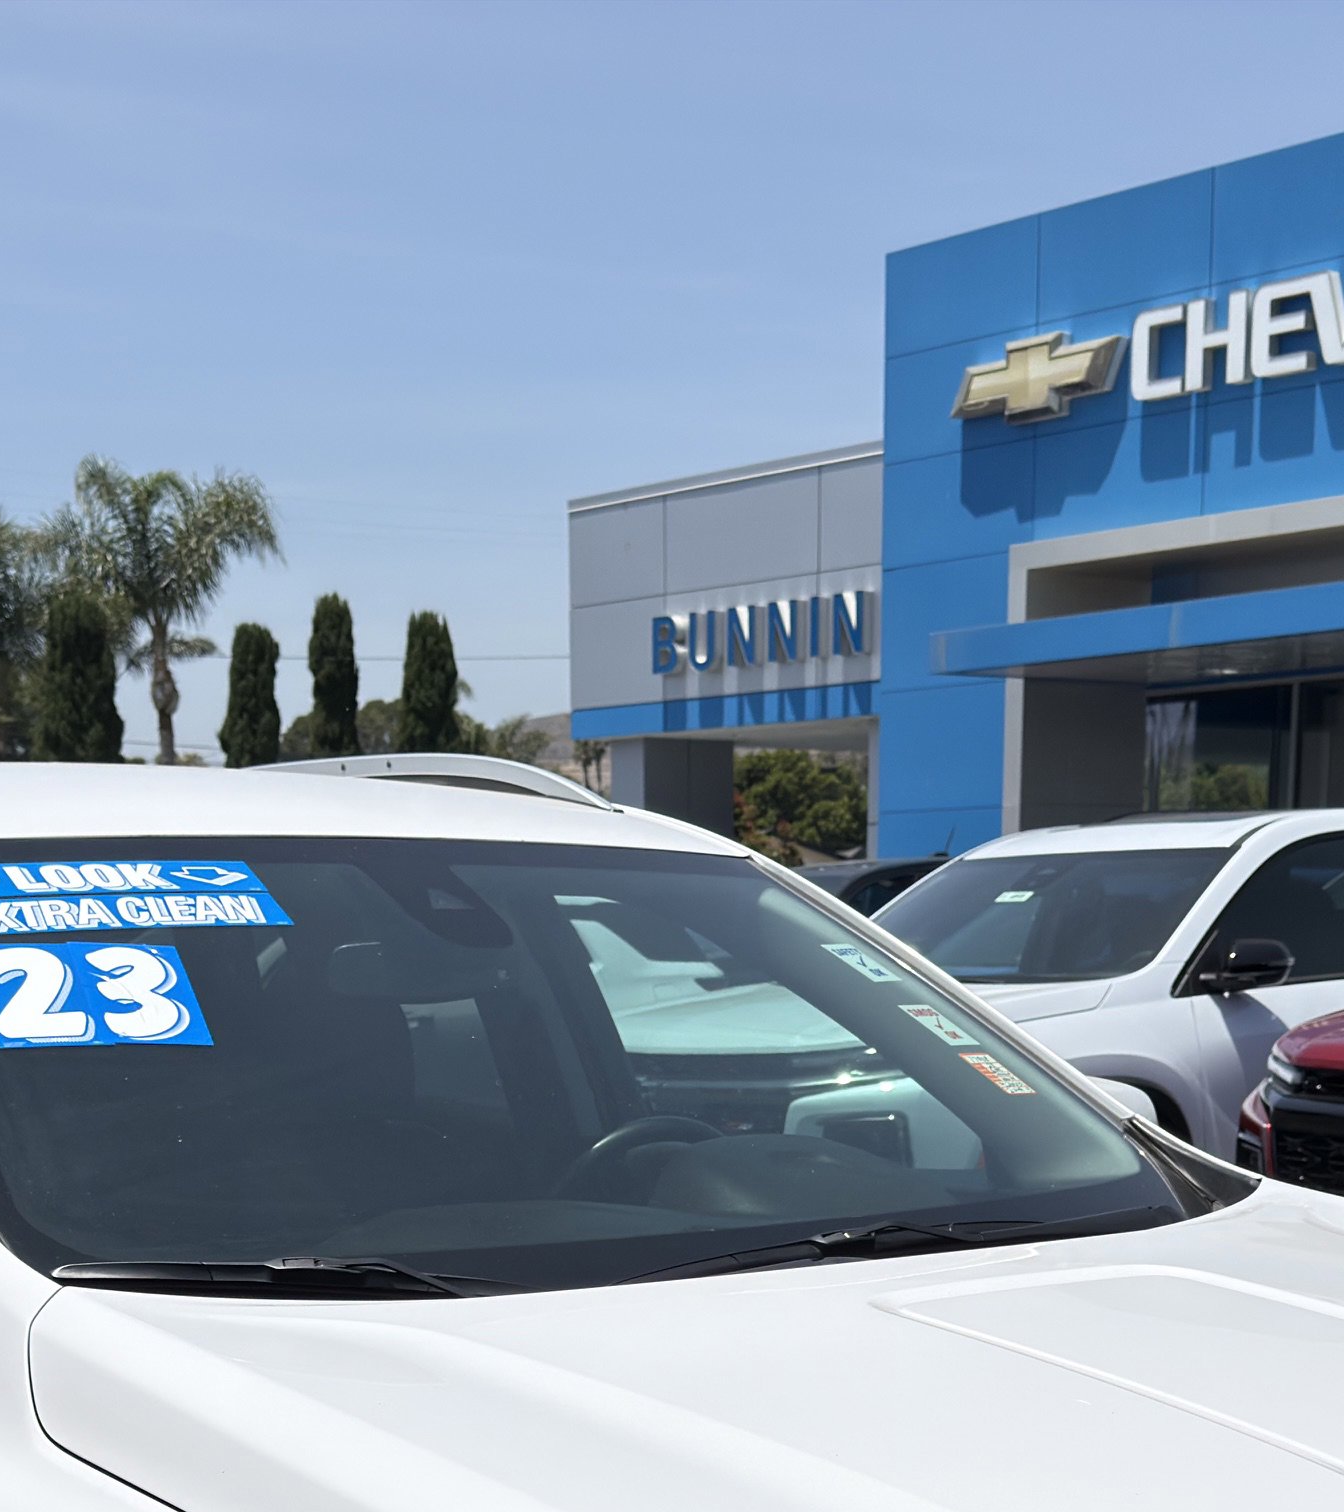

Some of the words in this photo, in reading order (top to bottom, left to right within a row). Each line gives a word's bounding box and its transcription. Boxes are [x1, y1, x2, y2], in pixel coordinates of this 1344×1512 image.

[652, 590, 869, 675] BUNNIN
[2, 863, 177, 893] LOOK
[118, 895, 266, 927] CLEAN
